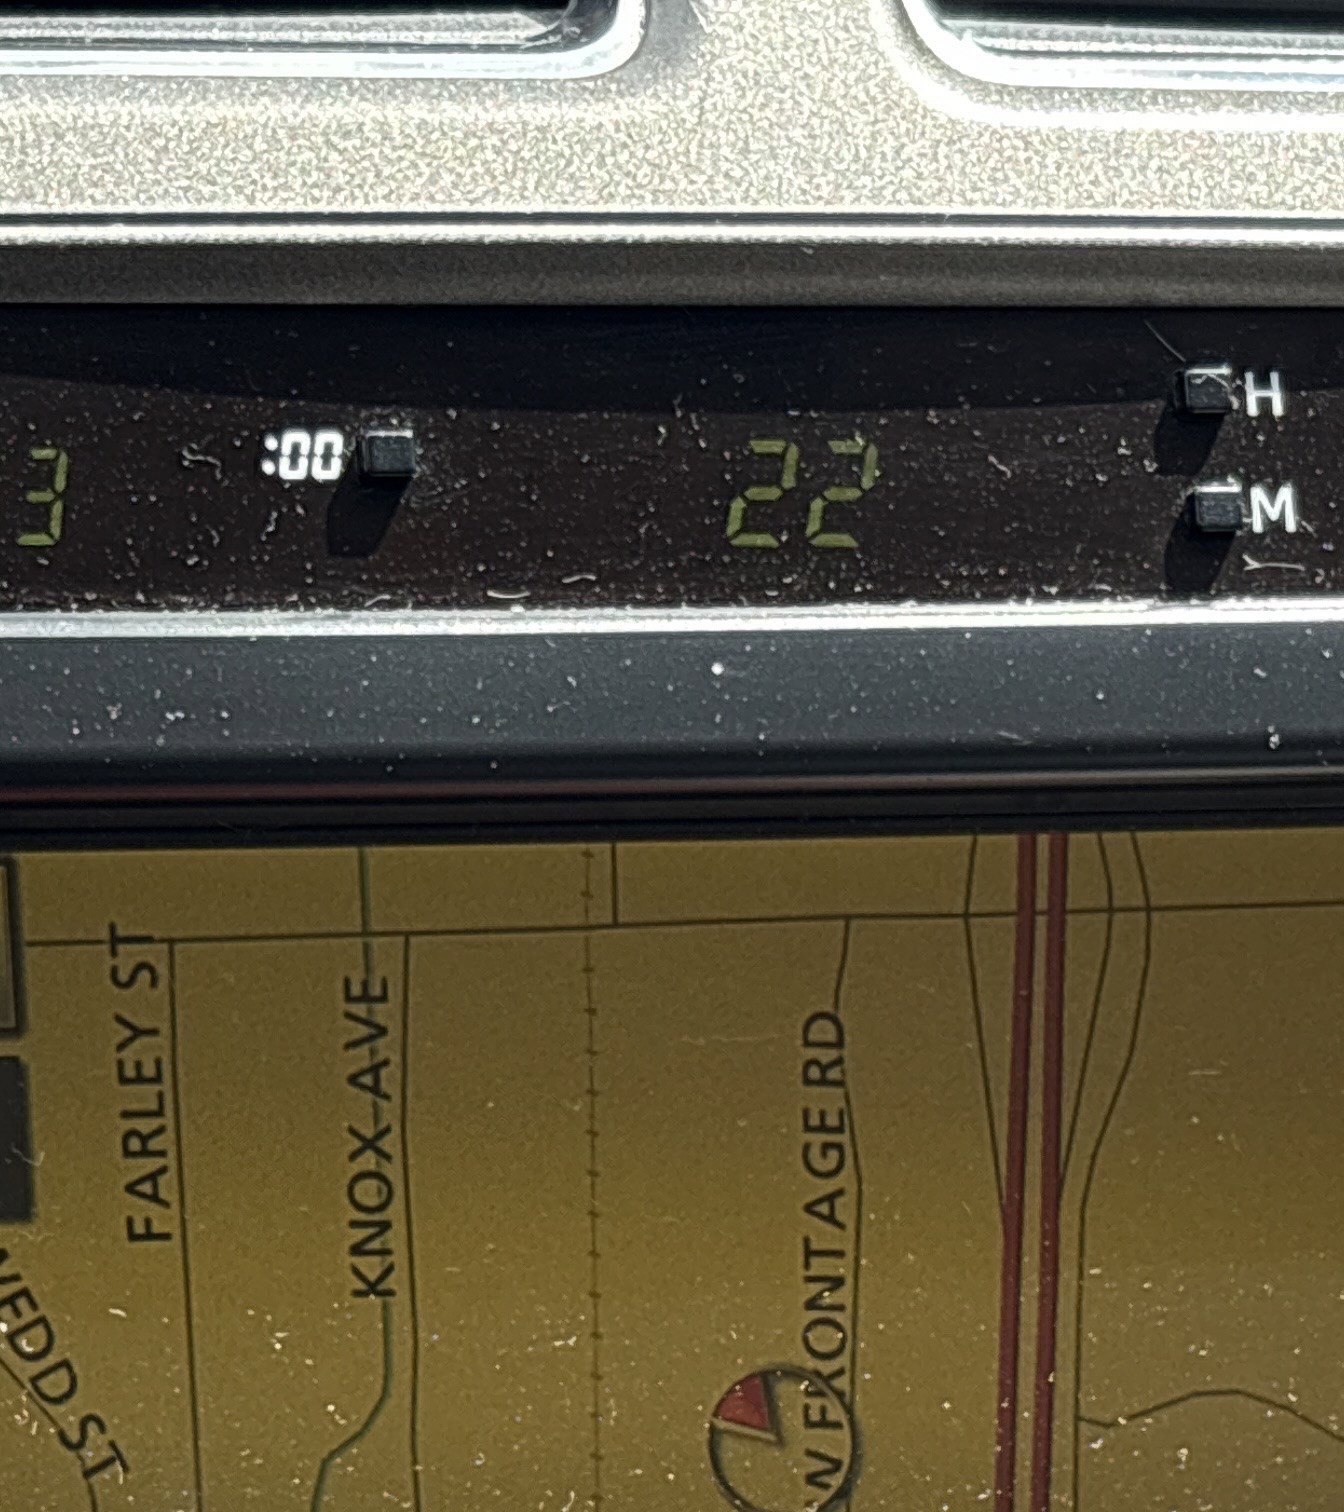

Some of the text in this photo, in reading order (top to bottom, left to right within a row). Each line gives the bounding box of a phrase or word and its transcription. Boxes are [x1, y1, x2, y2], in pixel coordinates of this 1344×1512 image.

[1244, 371, 1285, 417] H
[727, 439, 877, 547] 22
[1250, 484, 1297, 533] M
[108, 921, 173, 1243] FARLEY ST
[802, 1010, 846, 1088] RD
[343, 976, 396, 1299] KNOX AVE
[58, 1413, 129, 1480] ST
